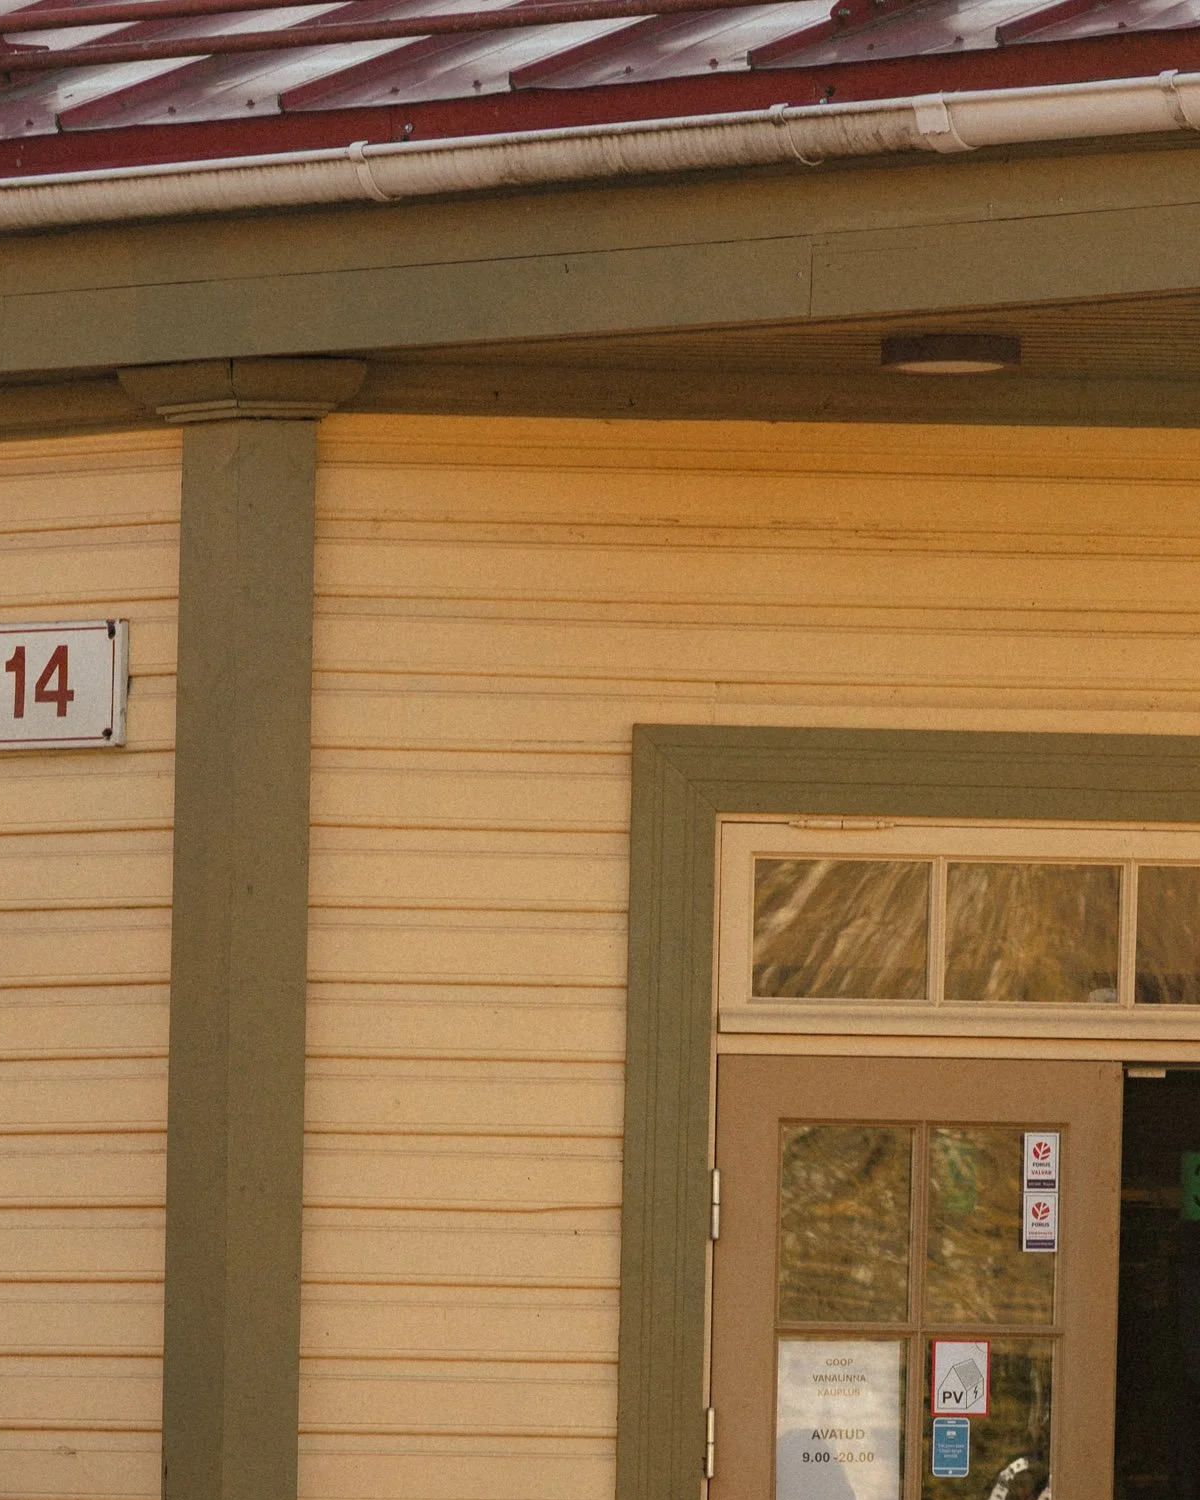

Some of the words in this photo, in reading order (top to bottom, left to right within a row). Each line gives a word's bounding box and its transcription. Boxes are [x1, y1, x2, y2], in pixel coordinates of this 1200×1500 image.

[5, 644, 75, 719] 14
[825, 1358, 854, 1367] COOP
[817, 1388, 861, 1397] KAUPLUS
[942, 1390, 964, 1404] PV
[811, 1428, 865, 1441] AVATUD
[802, 1451, 831, 1463] 9.00
